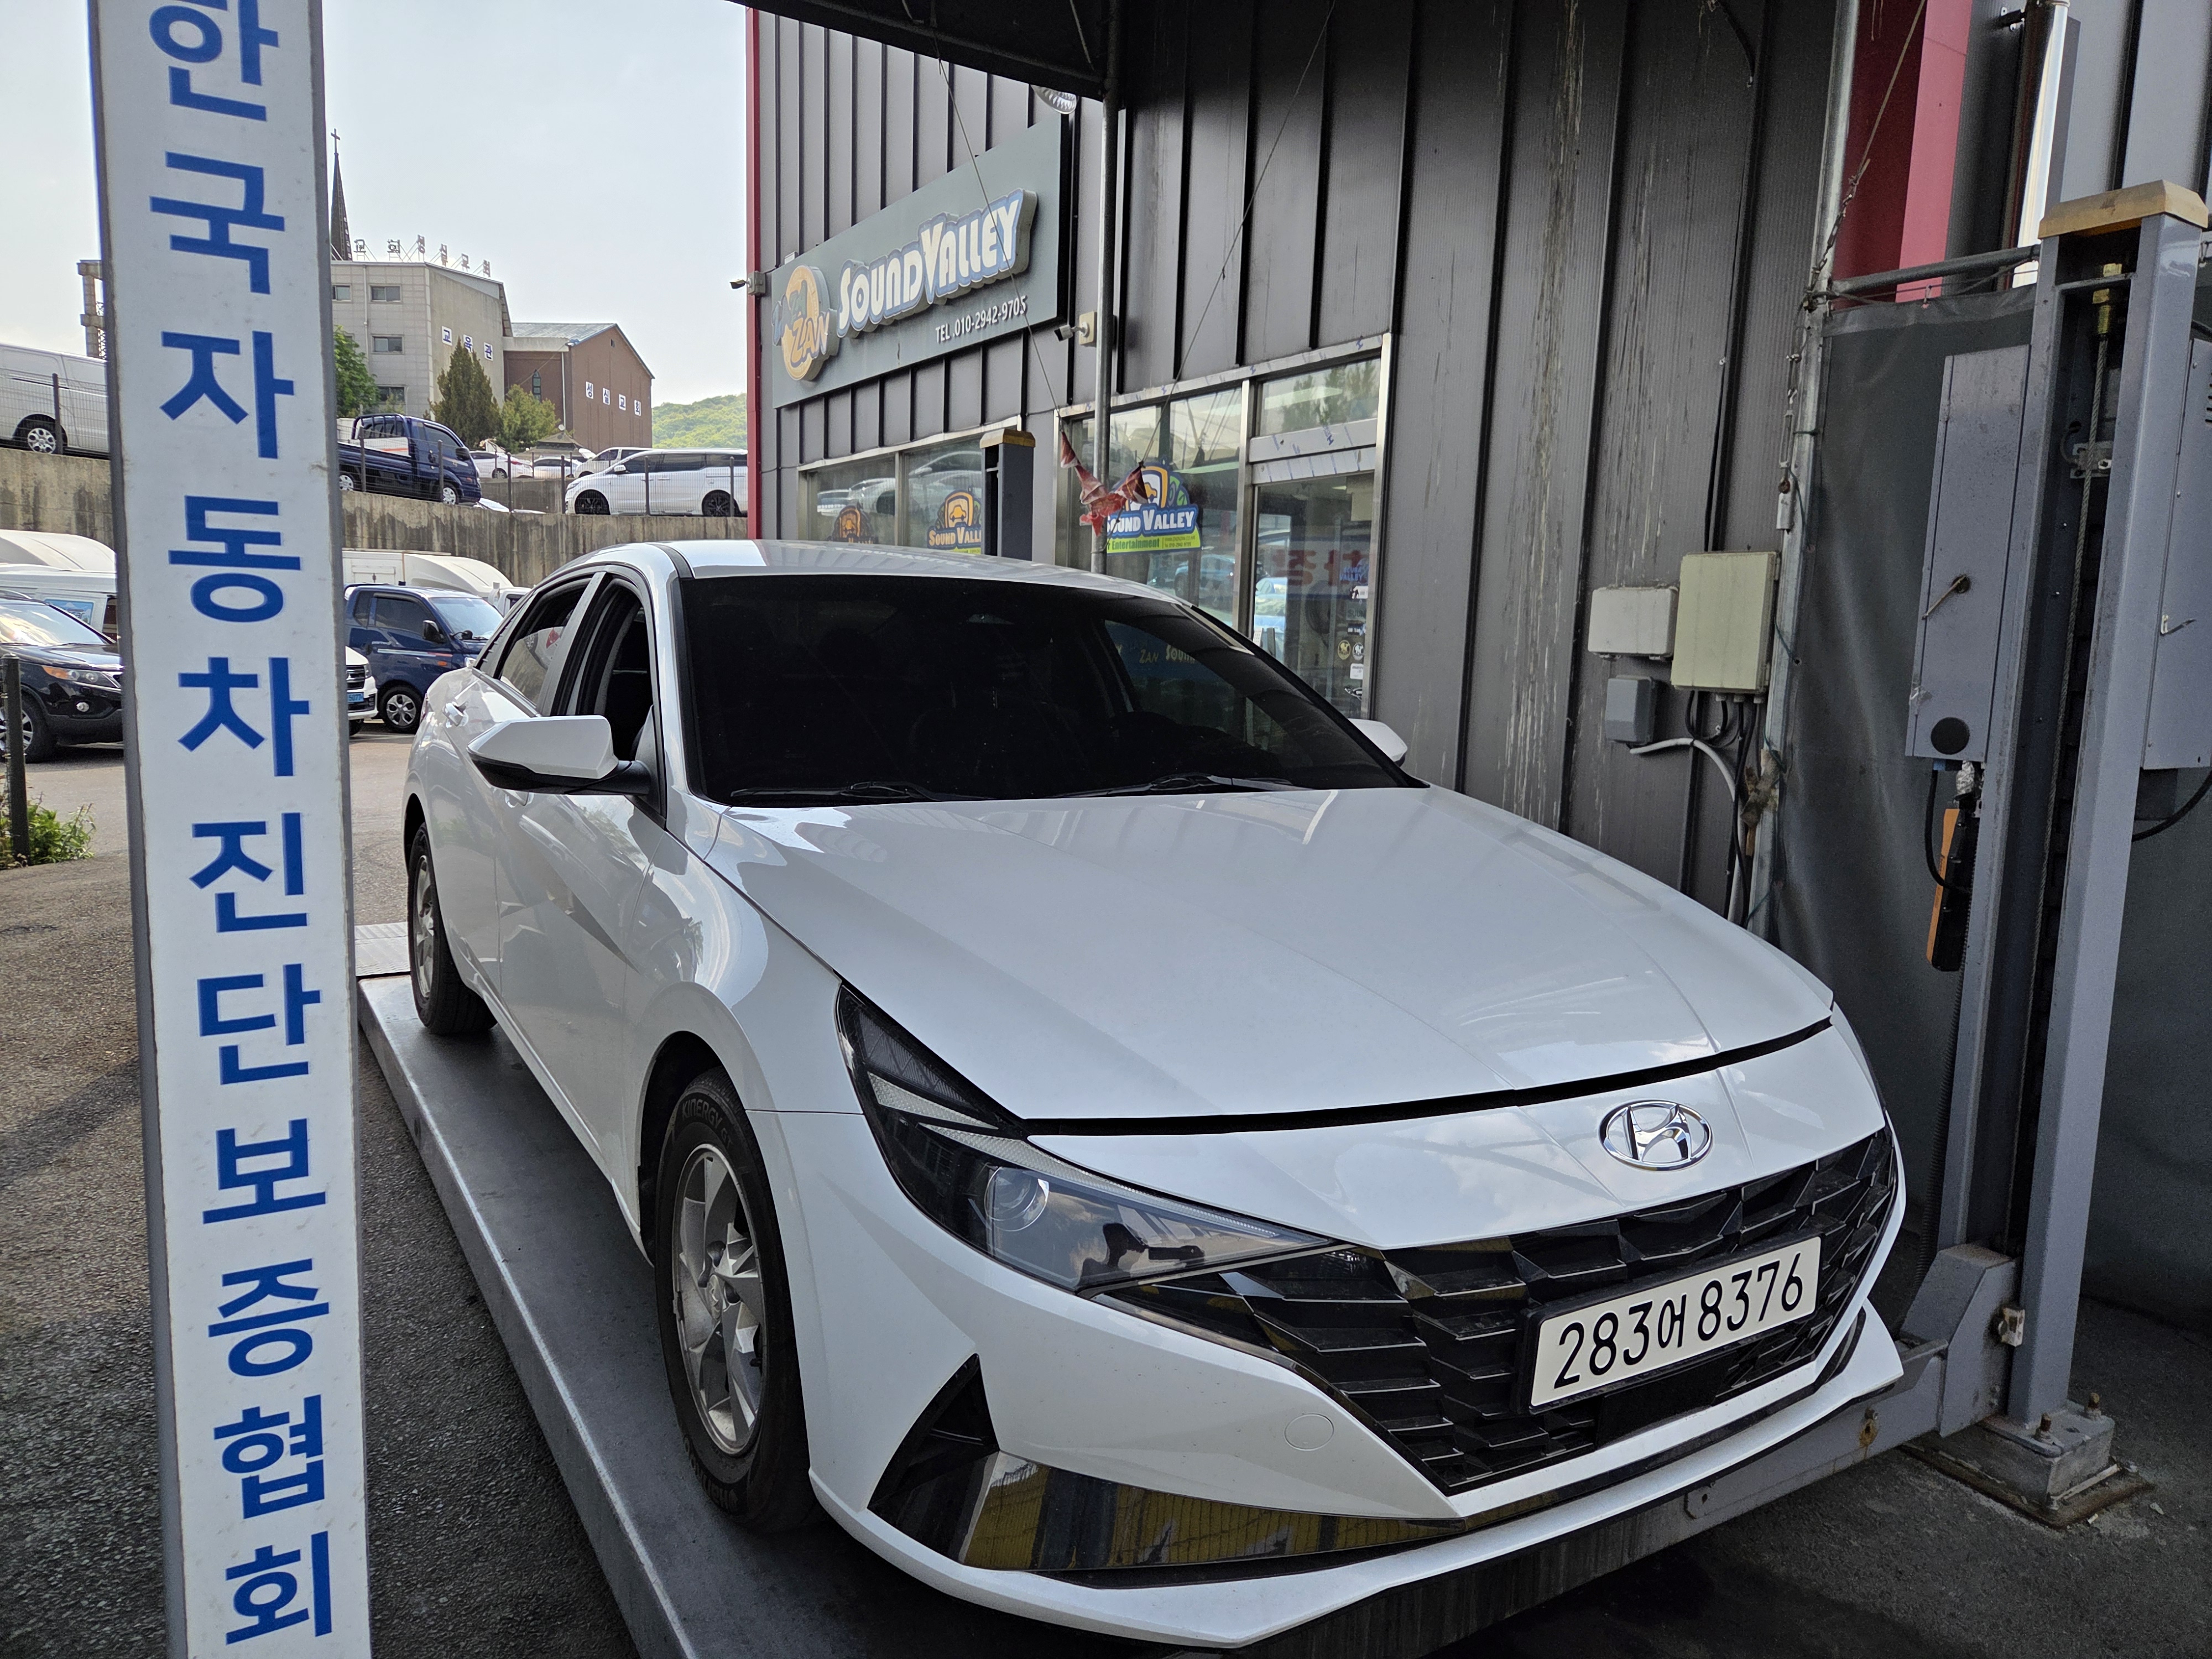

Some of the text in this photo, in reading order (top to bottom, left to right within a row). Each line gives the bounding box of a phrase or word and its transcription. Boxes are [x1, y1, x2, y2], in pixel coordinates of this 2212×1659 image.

[443, 329, 492, 359] 교육관
[587, 383, 640, 415] 성실교회
[1142, 509, 1194, 531] VALLEY
[929, 526, 982, 546] SOUND VALL
[1112, 538, 1160, 550] Entertainment
[682, 1098, 723, 1129] KINERGY
